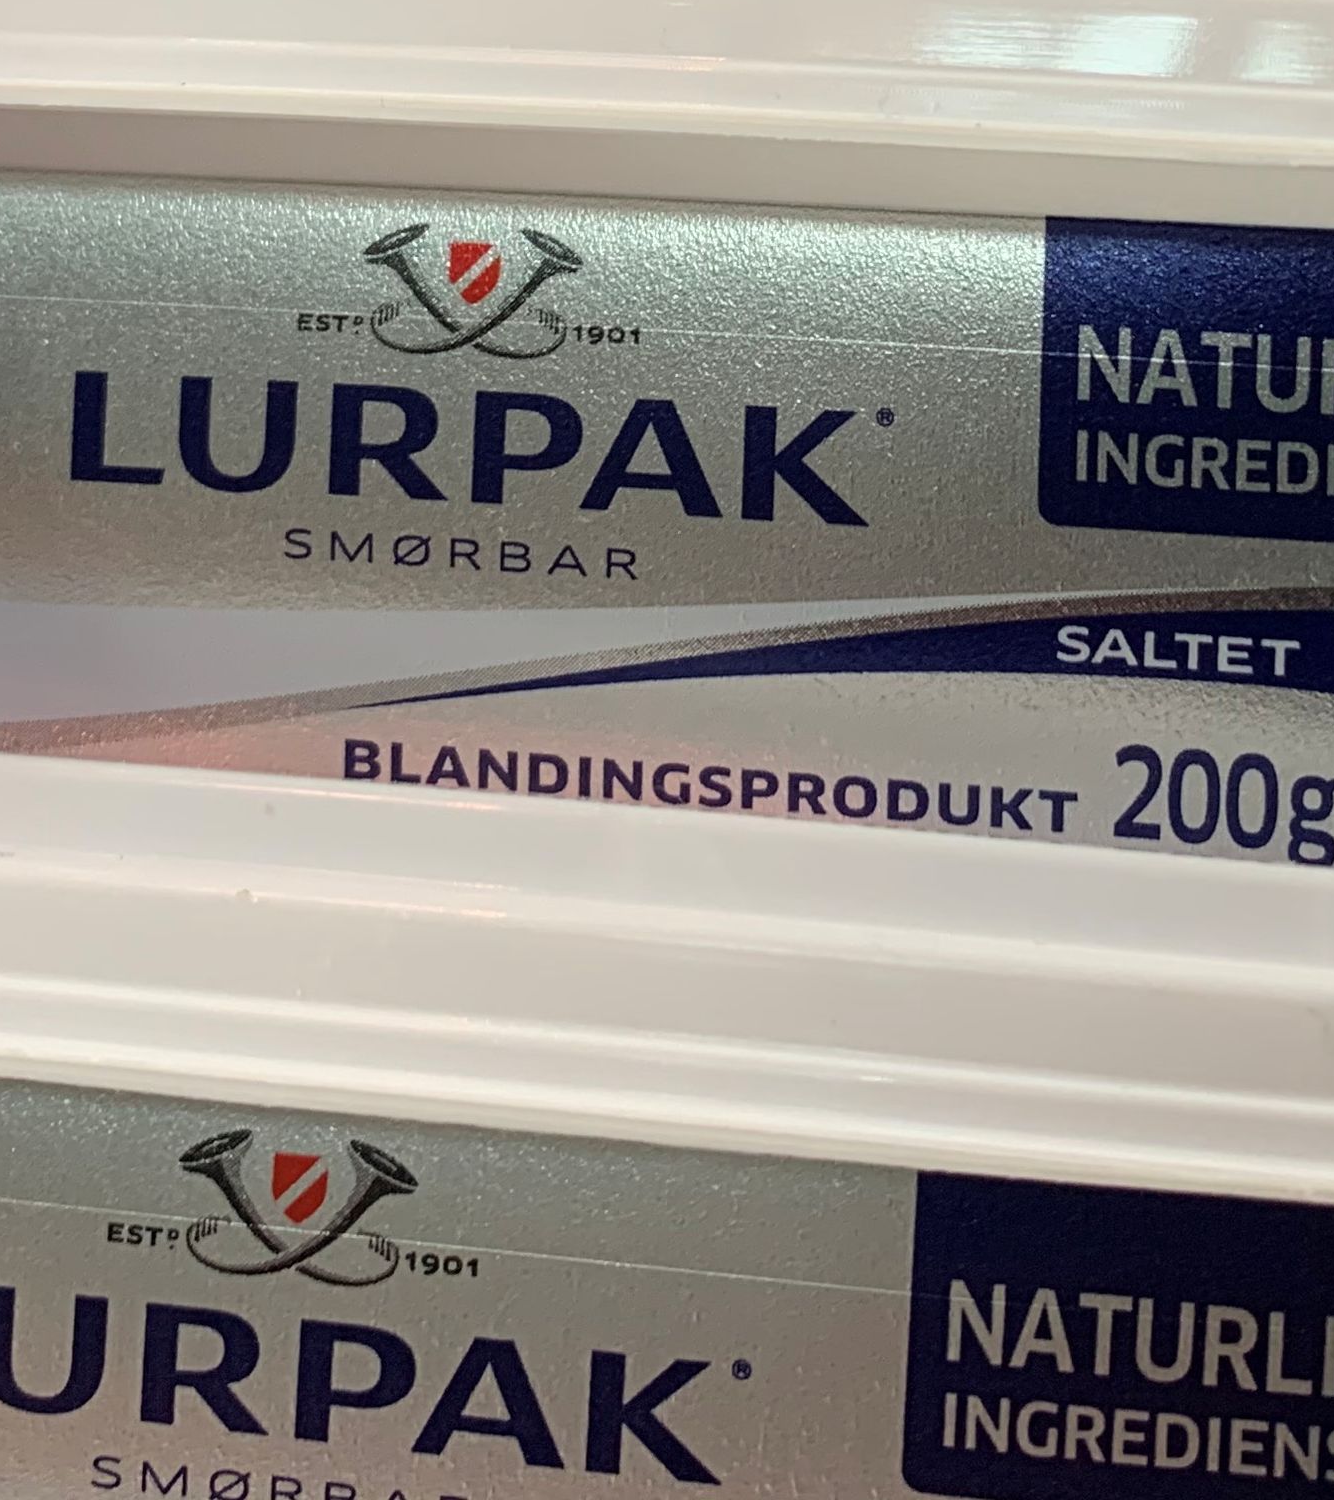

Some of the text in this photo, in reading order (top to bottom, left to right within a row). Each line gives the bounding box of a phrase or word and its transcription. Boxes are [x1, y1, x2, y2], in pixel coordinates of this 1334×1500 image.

[573, 323, 643, 346] 1901
[283, 527, 638, 580] SMØRBAR
[1055, 625, 1300, 675] SALTET
[343, 738, 1078, 833] BLANDINGSPRODUKT
[405, 1252, 479, 1277] 1901
